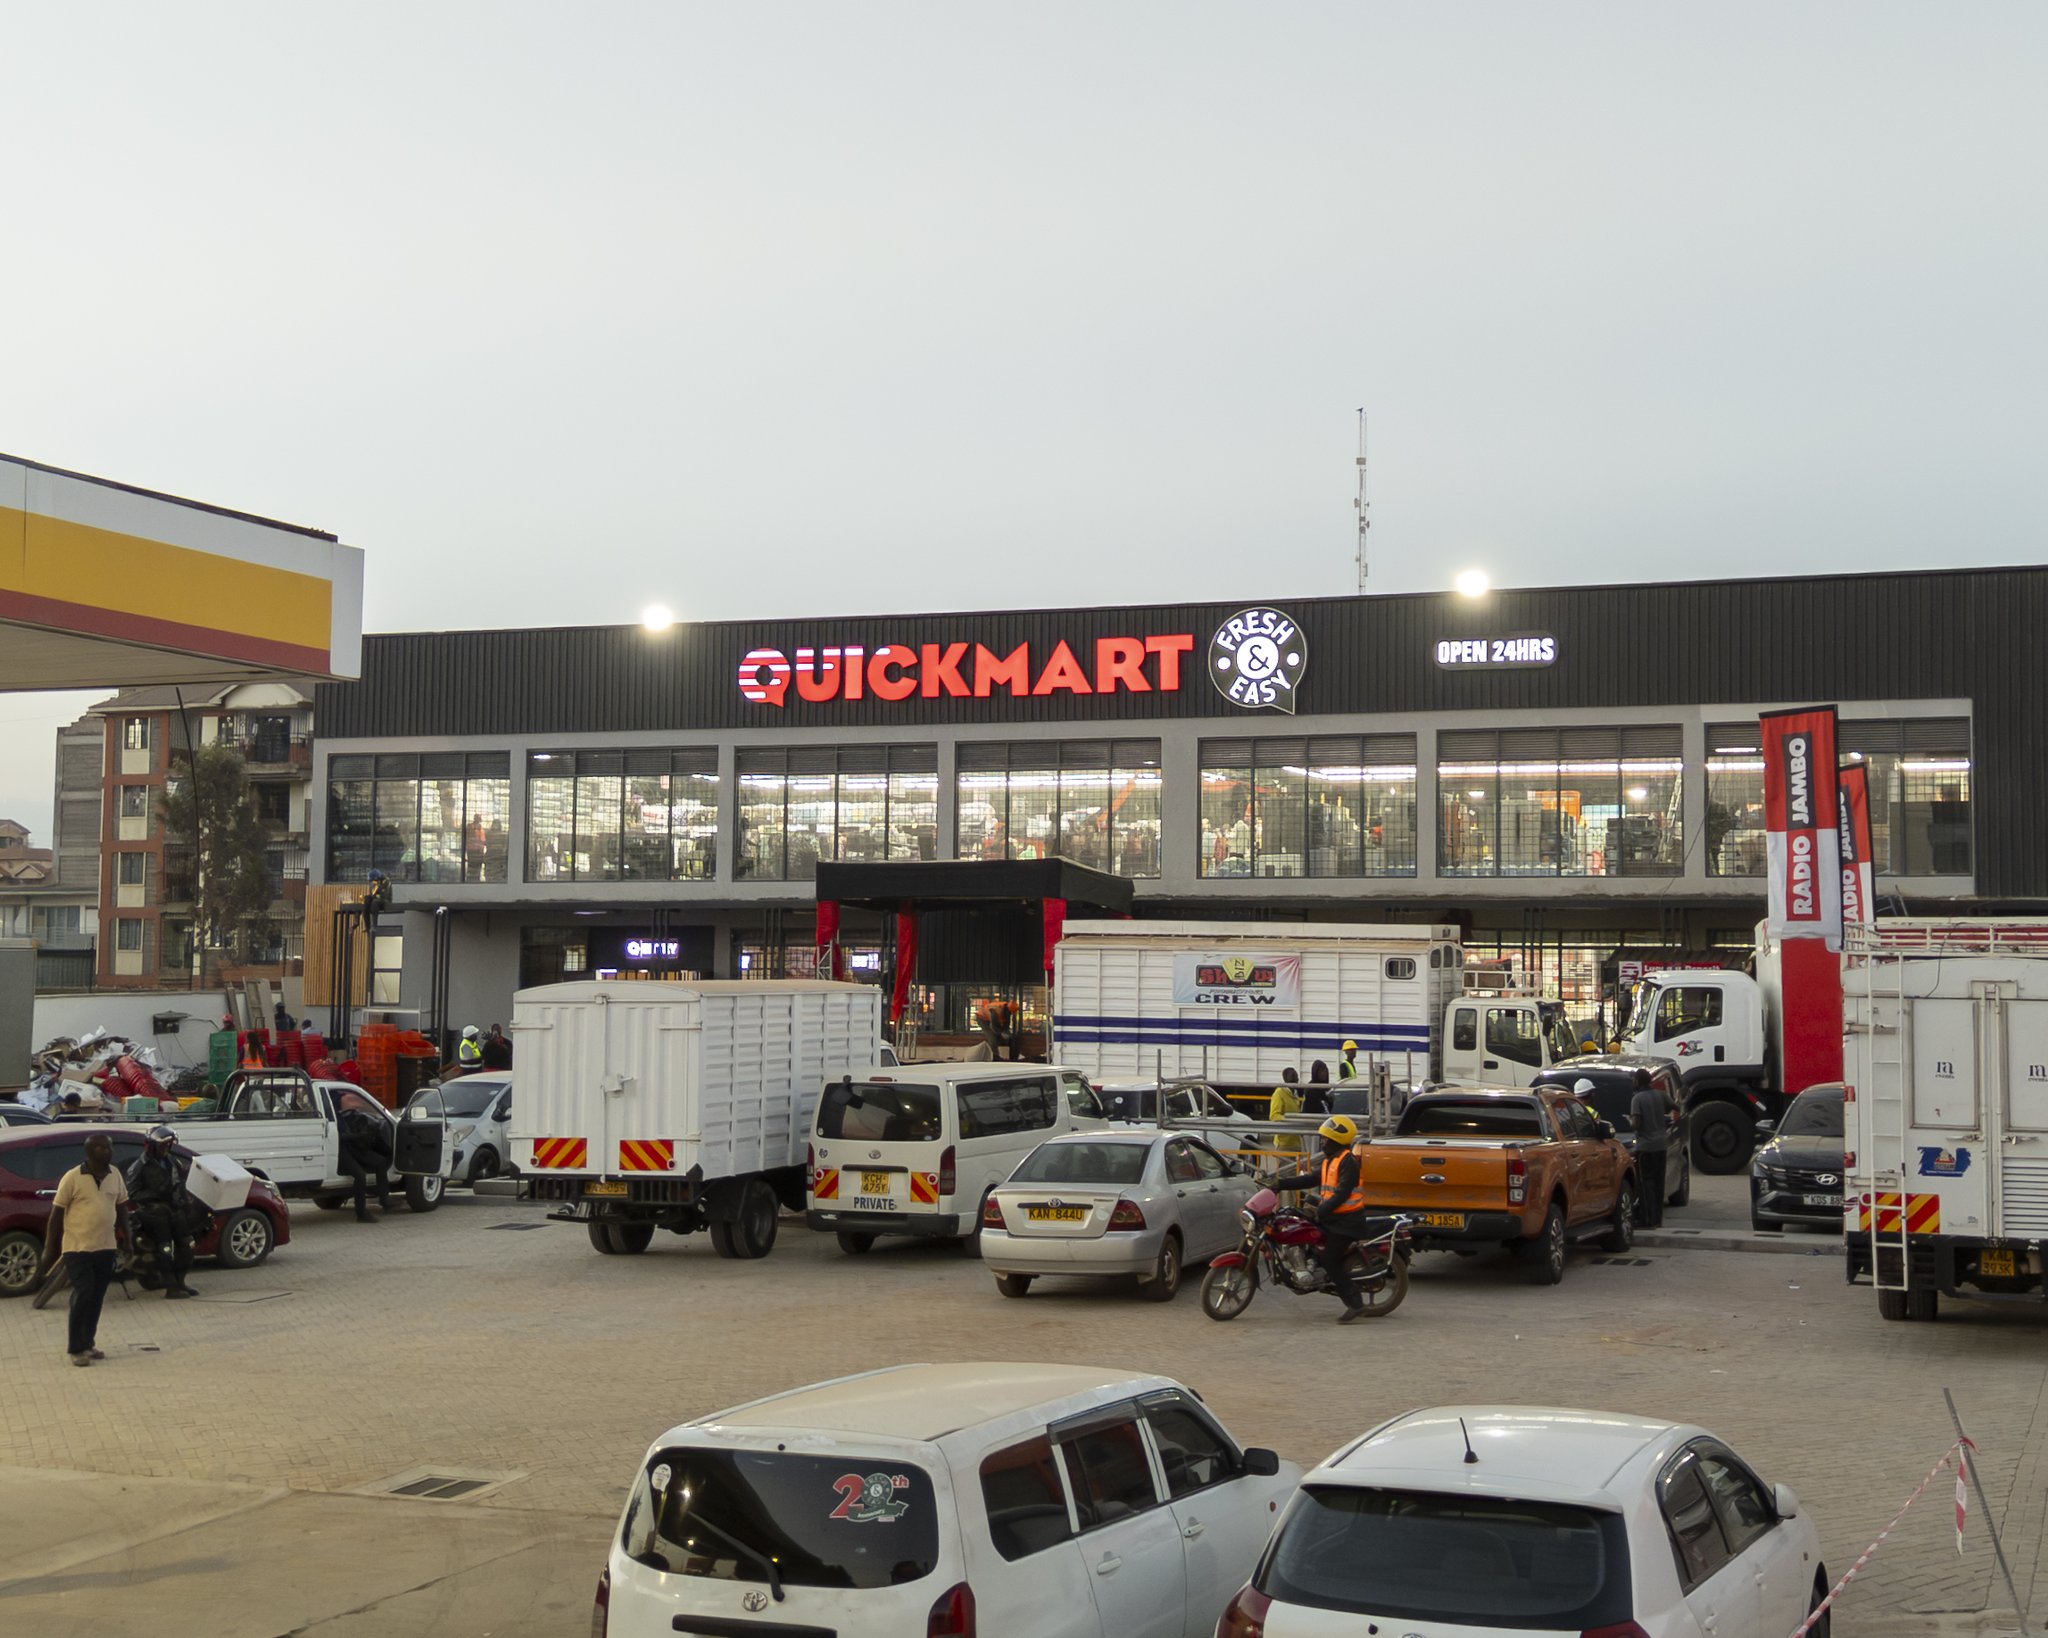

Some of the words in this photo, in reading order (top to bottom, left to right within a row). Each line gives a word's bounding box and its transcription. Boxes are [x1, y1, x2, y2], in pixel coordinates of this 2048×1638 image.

[1216, 610, 1295, 651] FRESH
[1248, 644, 1270, 672] &
[1437, 640, 1488, 664] OPEN
[1491, 637, 1555, 662] 24HRS
[738, 634, 1194, 708] QUICKMART
[1228, 668, 1292, 705] EASY
[1788, 737, 1809, 825] JAMBO
[1793, 834, 1813, 915] RADIO
[1842, 869, 1859, 923] ADIO
[1195, 993, 1276, 1005] CREW
[862, 1183, 886, 1192] 475Y
[863, 1173, 883, 1183] KCH
[853, 1196, 895, 1211] PRIVATE
[1028, 1208, 1050, 1220] KAN
[1055, 1208, 1083, 1220] 844U
